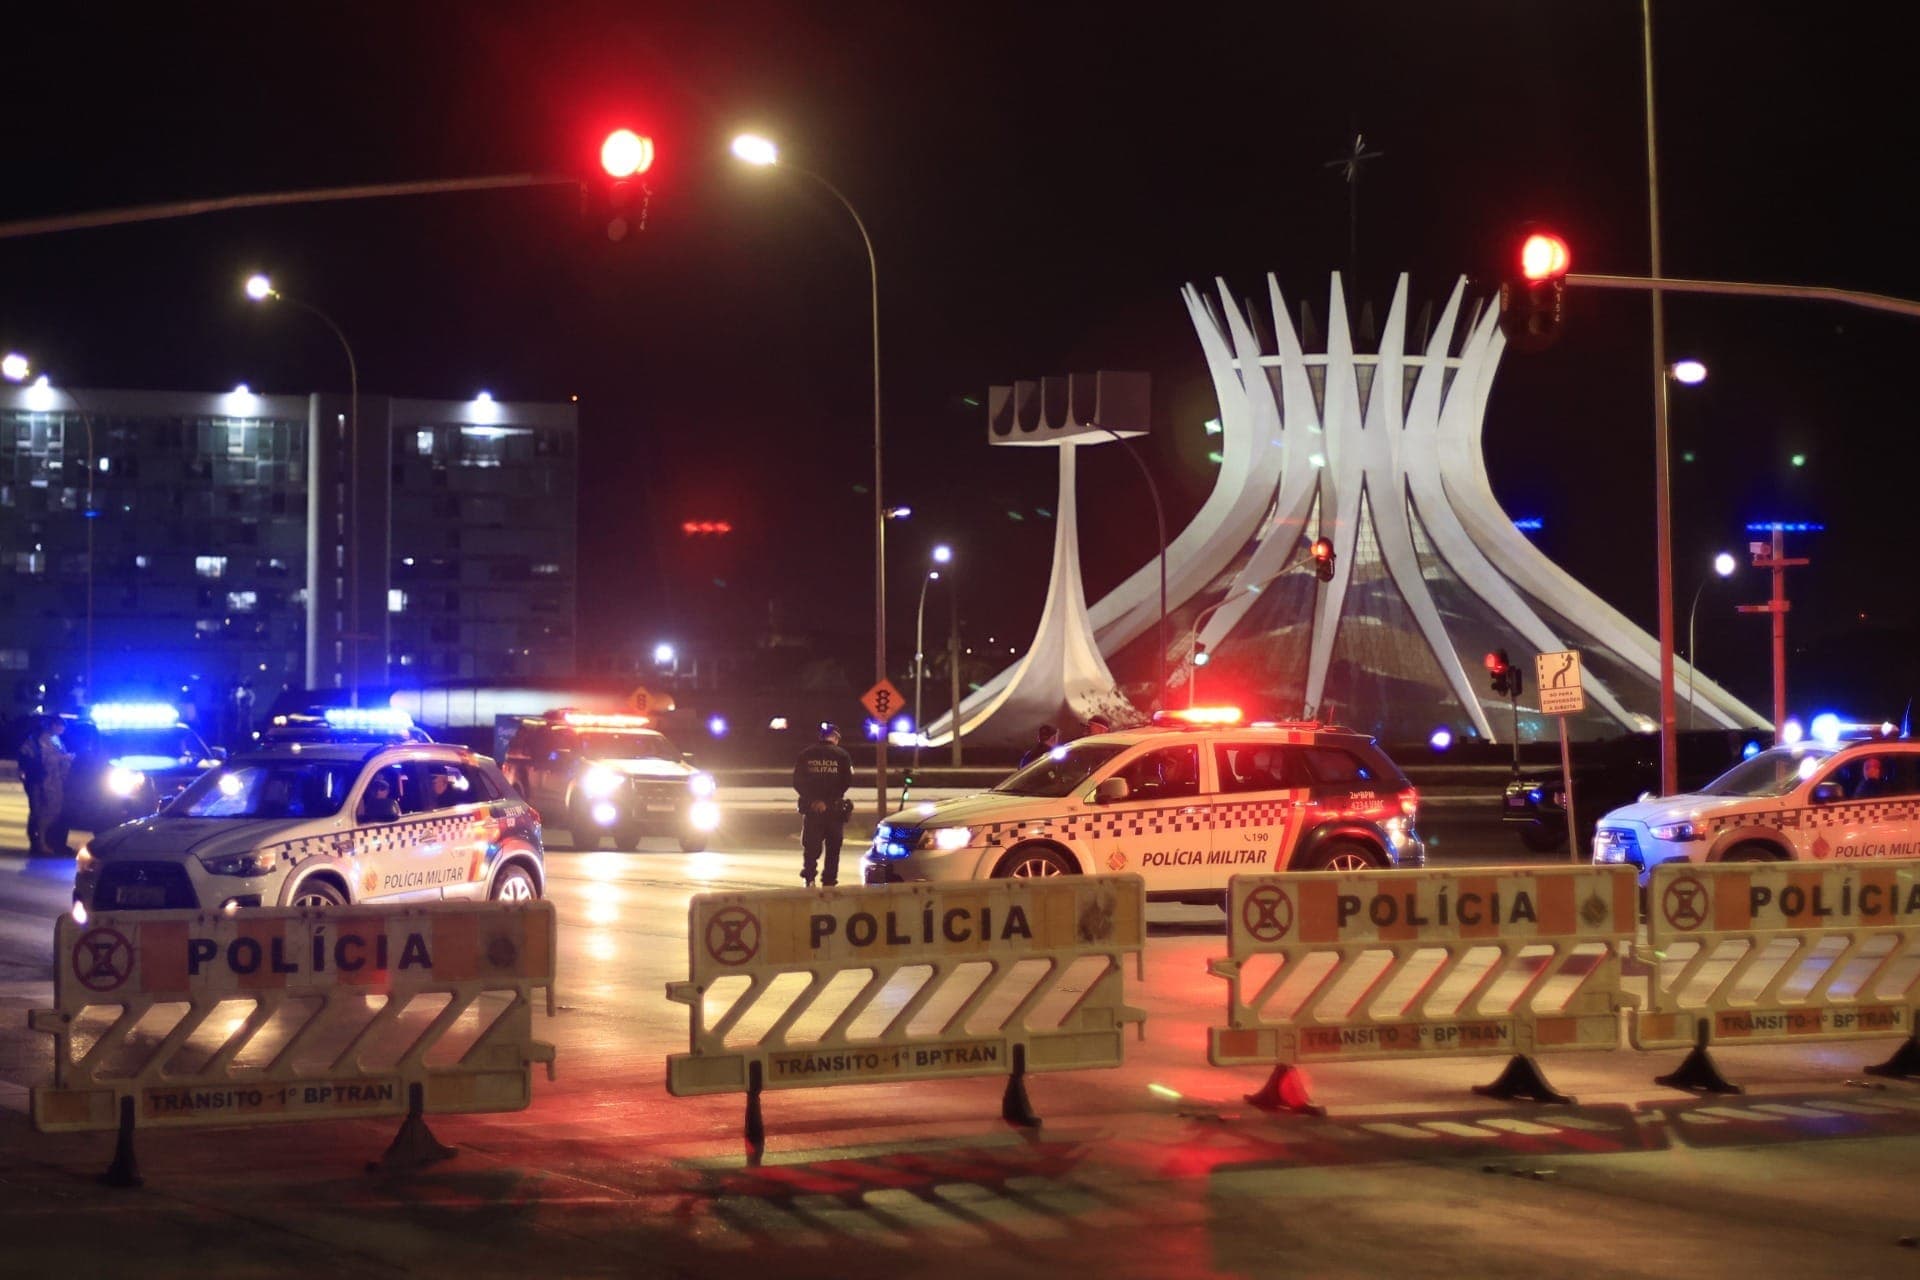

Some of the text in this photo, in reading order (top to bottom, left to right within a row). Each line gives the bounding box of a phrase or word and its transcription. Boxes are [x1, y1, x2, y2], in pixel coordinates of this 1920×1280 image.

[1252, 832, 1269, 842] 190
[1142, 848, 1267, 867] POLÍCIA MILITAR
[1835, 843, 1886, 858] POLÍCIA
[384, 867, 464, 889] POLÍCIA MILITAR
[1336, 886, 1538, 928] POLÍCIA
[810, 901, 1033, 949] POLÍCIA
[187, 926, 433, 975] POLÍCIA
[1833, 1011, 1900, 1028] BPTRAN
[1433, 1025, 1507, 1043] BPTRAN
[915, 1045, 997, 1067] BPTRAN
[304, 1083, 393, 1104] BPTRAN
